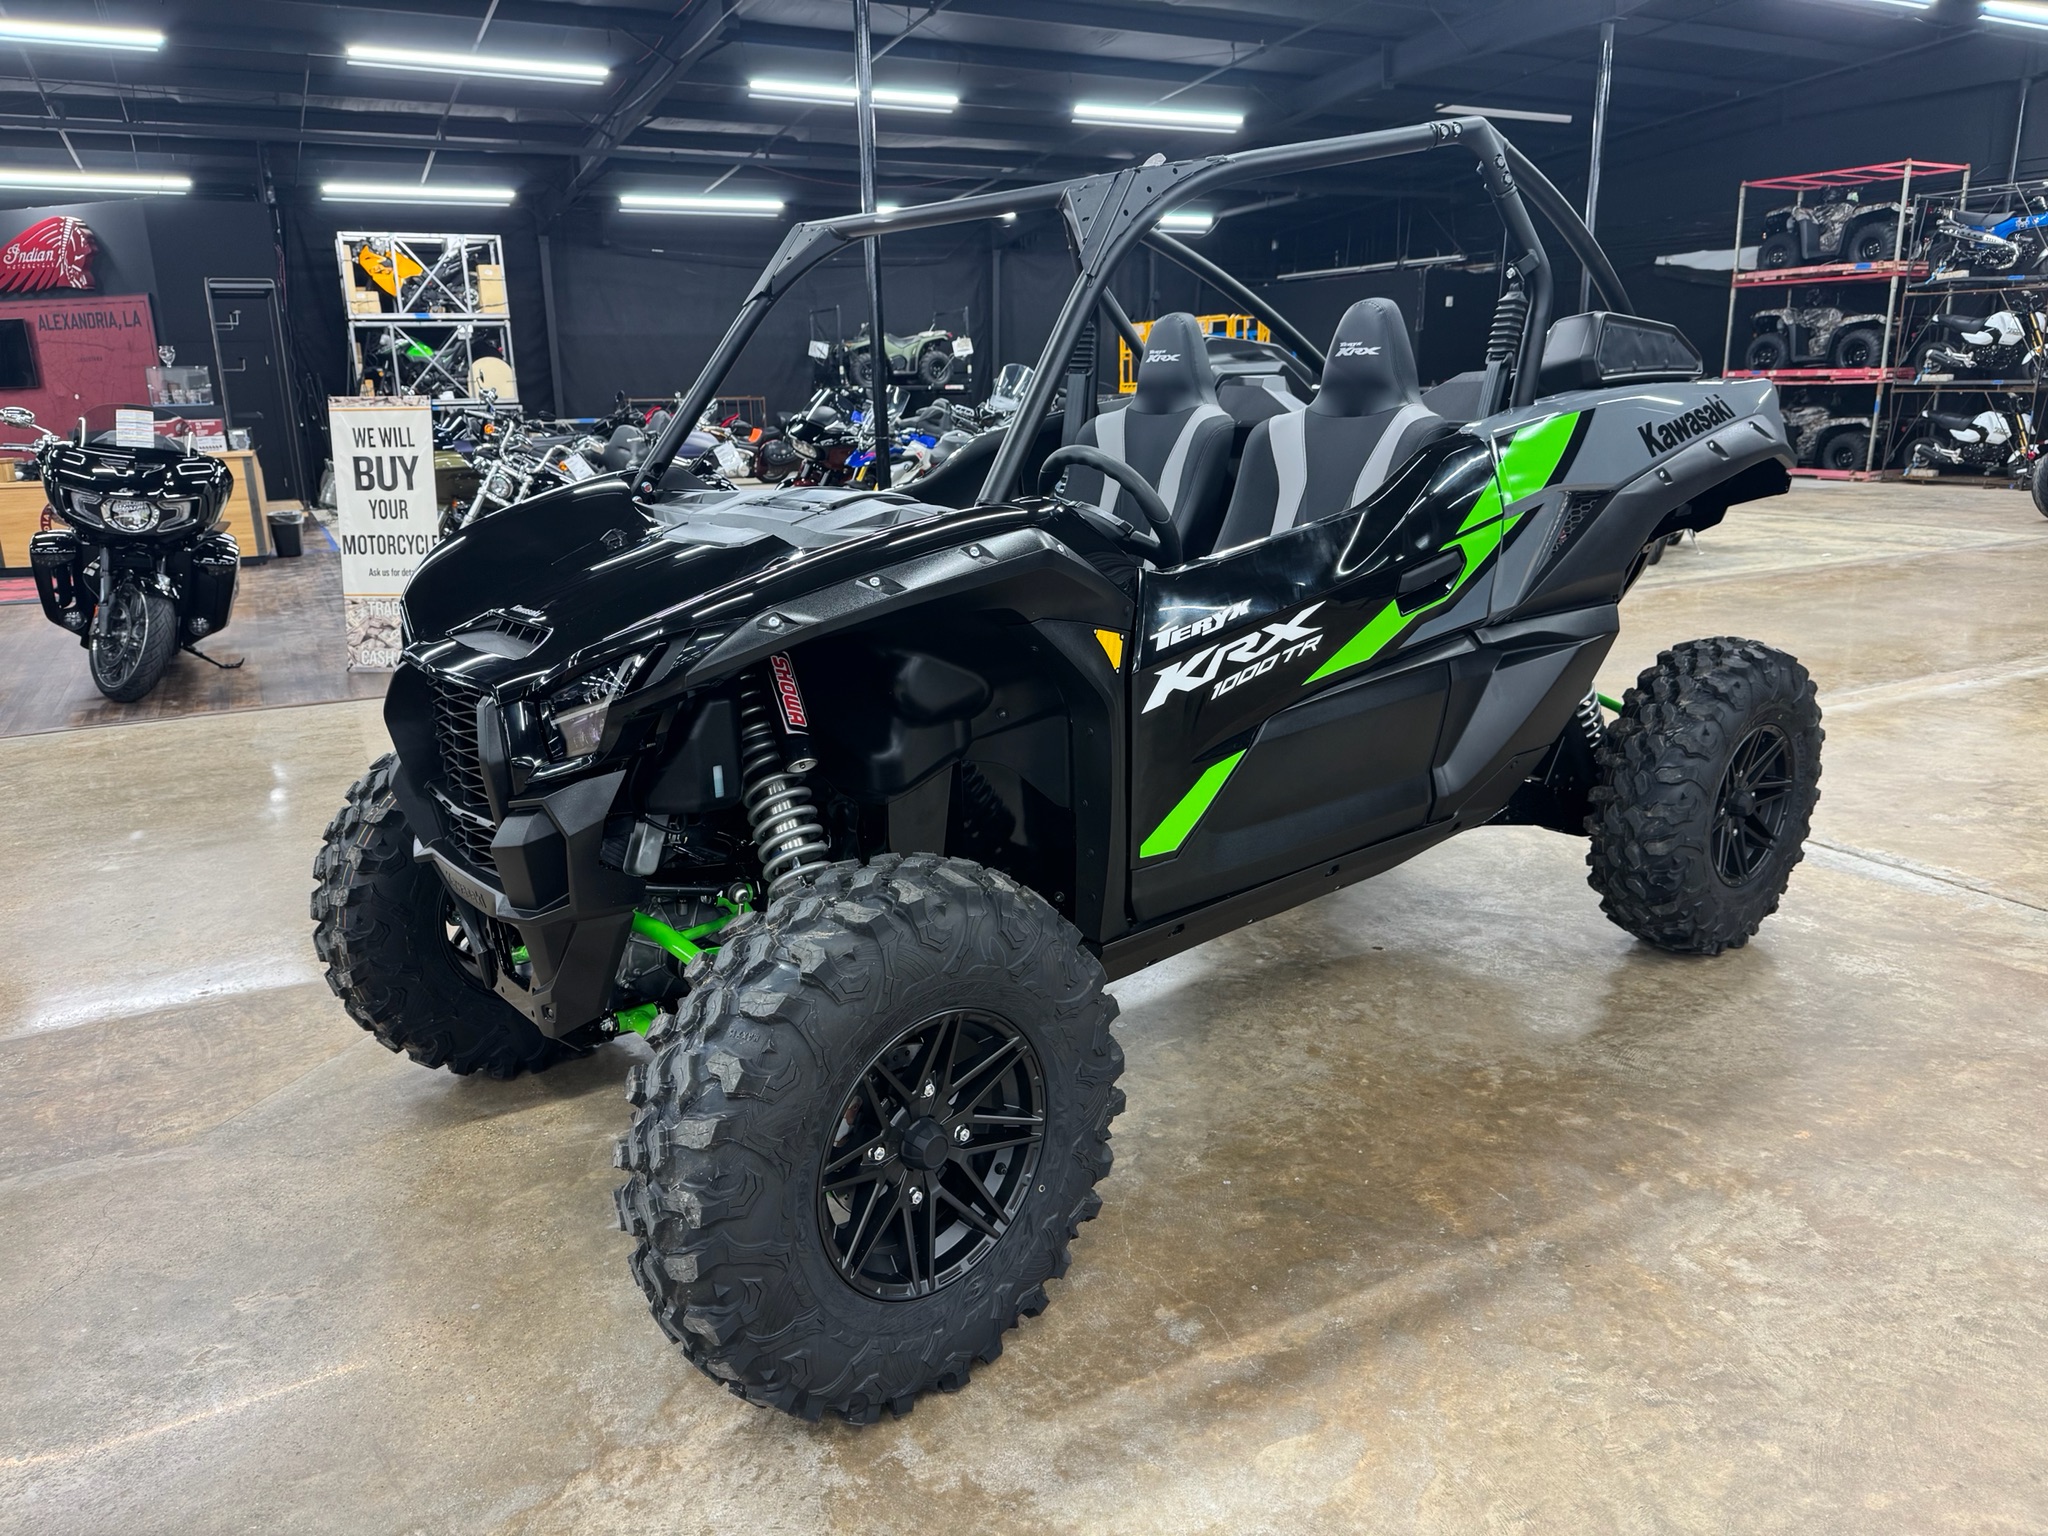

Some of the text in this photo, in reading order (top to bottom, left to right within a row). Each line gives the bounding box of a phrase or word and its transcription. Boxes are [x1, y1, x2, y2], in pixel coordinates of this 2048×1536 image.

[3, 243, 54, 265] Indian
[38, 310, 142, 331] ALEXANDRIA, LA
[1145, 354, 1181, 363] KRX
[1335, 346, 1382, 357] KRX
[1637, 394, 1736, 458] Kawasaki
[352, 427, 415, 448] WE WILL
[352, 456, 419, 491] BUY
[368, 499, 409, 520] YOUR
[369, 567, 381, 577] Ask
[382, 569, 390, 577] us
[391, 567, 400, 577] for
[367, 601, 401, 616] TRAD
[1150, 599, 1252, 652] TERYX
[361, 649, 395, 665] CASH
[1141, 600, 1327, 714] KRX
[1211, 634, 1324, 700] 1000 TR
[770, 655, 808, 727] SHOWA
